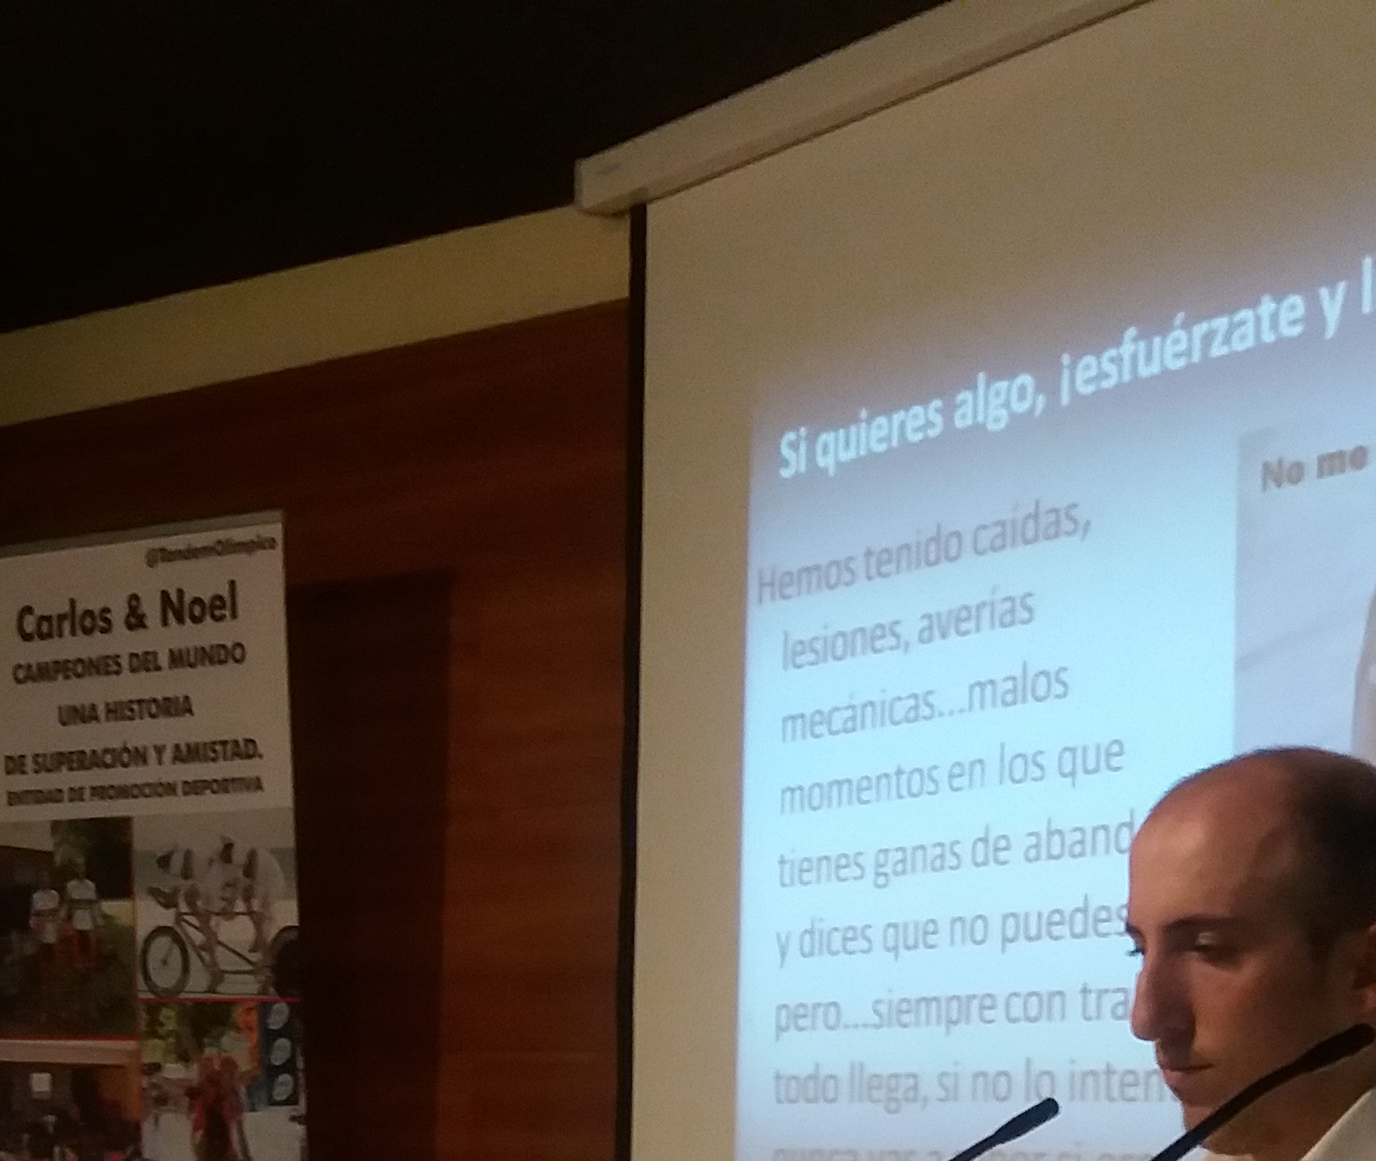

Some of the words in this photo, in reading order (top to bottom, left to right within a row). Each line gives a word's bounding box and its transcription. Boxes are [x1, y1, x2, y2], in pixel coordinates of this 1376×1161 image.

[779, 427, 805, 478] Si
[814, 397, 943, 476] quieres
[952, 366, 1045, 436] algo,
[1060, 286, 1305, 405] ¡esfuérzate
[1318, 284, 1349, 342] y
[1260, 453, 1305, 493] No
[1316, 443, 1369, 479] me
[756, 557, 856, 605] Hemos
[863, 523, 962, 585] tenido
[972, 499, 1093, 557] caídas,
[16, 597, 113, 643] Carlos
[124, 592, 149, 632] &
[159, 579, 239, 629] Noel
[781, 617, 911, 672] lesiones,
[917, 587, 1036, 648] averías
[12, 653, 123, 685] CAMPEONES
[129, 650, 163, 674] DEL
[168, 641, 247, 671] MUNDO
[57, 701, 100, 728] UNA
[105, 694, 196, 724] HISTORIA
[3, 754, 29, 776] DE
[153, 744, 168, 766] Y
[171, 737, 265, 766] AMISTAD.
[778, 763, 941, 816] momentos
[947, 755, 987, 794] en
[997, 742, 1047, 788] los
[1056, 735, 1126, 798] que
[68, 785, 86, 803] DE
[181, 775, 265, 799] DEPORTIVA
[776, 843, 866, 890] tienes
[872, 836, 962, 890] ganas
[970, 826, 1013, 869] de
[1022, 807, 1135, 866] aband
[775, 930, 793, 971] y
[798, 916, 874, 958] dices
[882, 913, 940, 963] que
[948, 911, 991, 948] no
[998, 893, 1130, 952] puedes
[1004, 984, 1067, 1026] con
[1079, 980, 1131, 1024] tra
[772, 1062, 840, 1107] todo
[847, 1060, 929, 1116] llega,
[934, 1060, 963, 1103] si
[970, 1064, 1015, 1103] no
[1022, 1057, 1059, 1103] lo
[1066, 1060, 1170, 1105] inten
